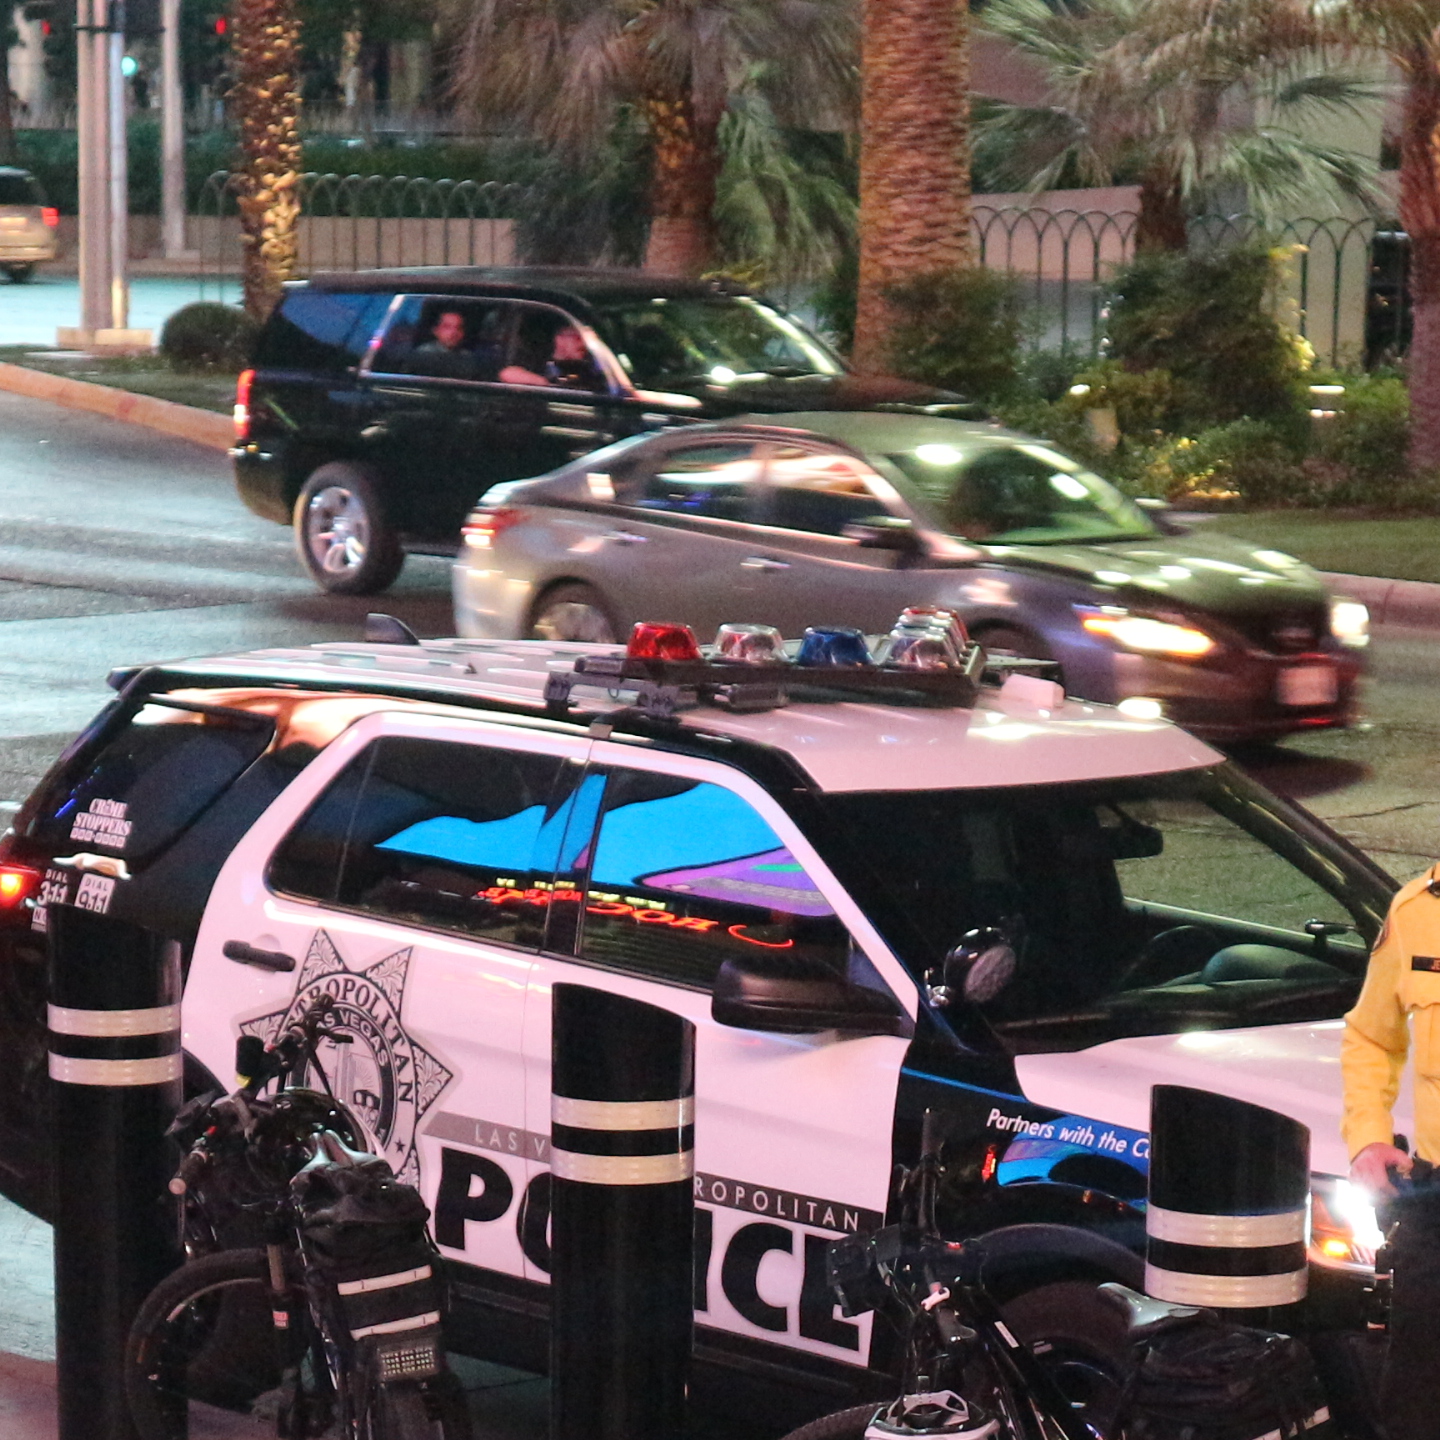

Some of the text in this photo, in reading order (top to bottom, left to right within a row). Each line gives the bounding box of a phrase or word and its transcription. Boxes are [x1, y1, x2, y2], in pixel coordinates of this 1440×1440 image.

[89, 798, 127, 819] CRIME
[73, 811, 133, 836] STOPPERS
[45, 869, 68, 883] DIAL
[85, 878, 109, 892] DIAL
[339, 1009, 389, 1067] VEGAS
[986, 1108, 1056, 1139] Partners
[1059, 1125, 1096, 1147] with
[1097, 1130, 1128, 1154] the
[474, 1123, 518, 1151] LAS
[694, 1172, 860, 1232] ROPOLITAN
